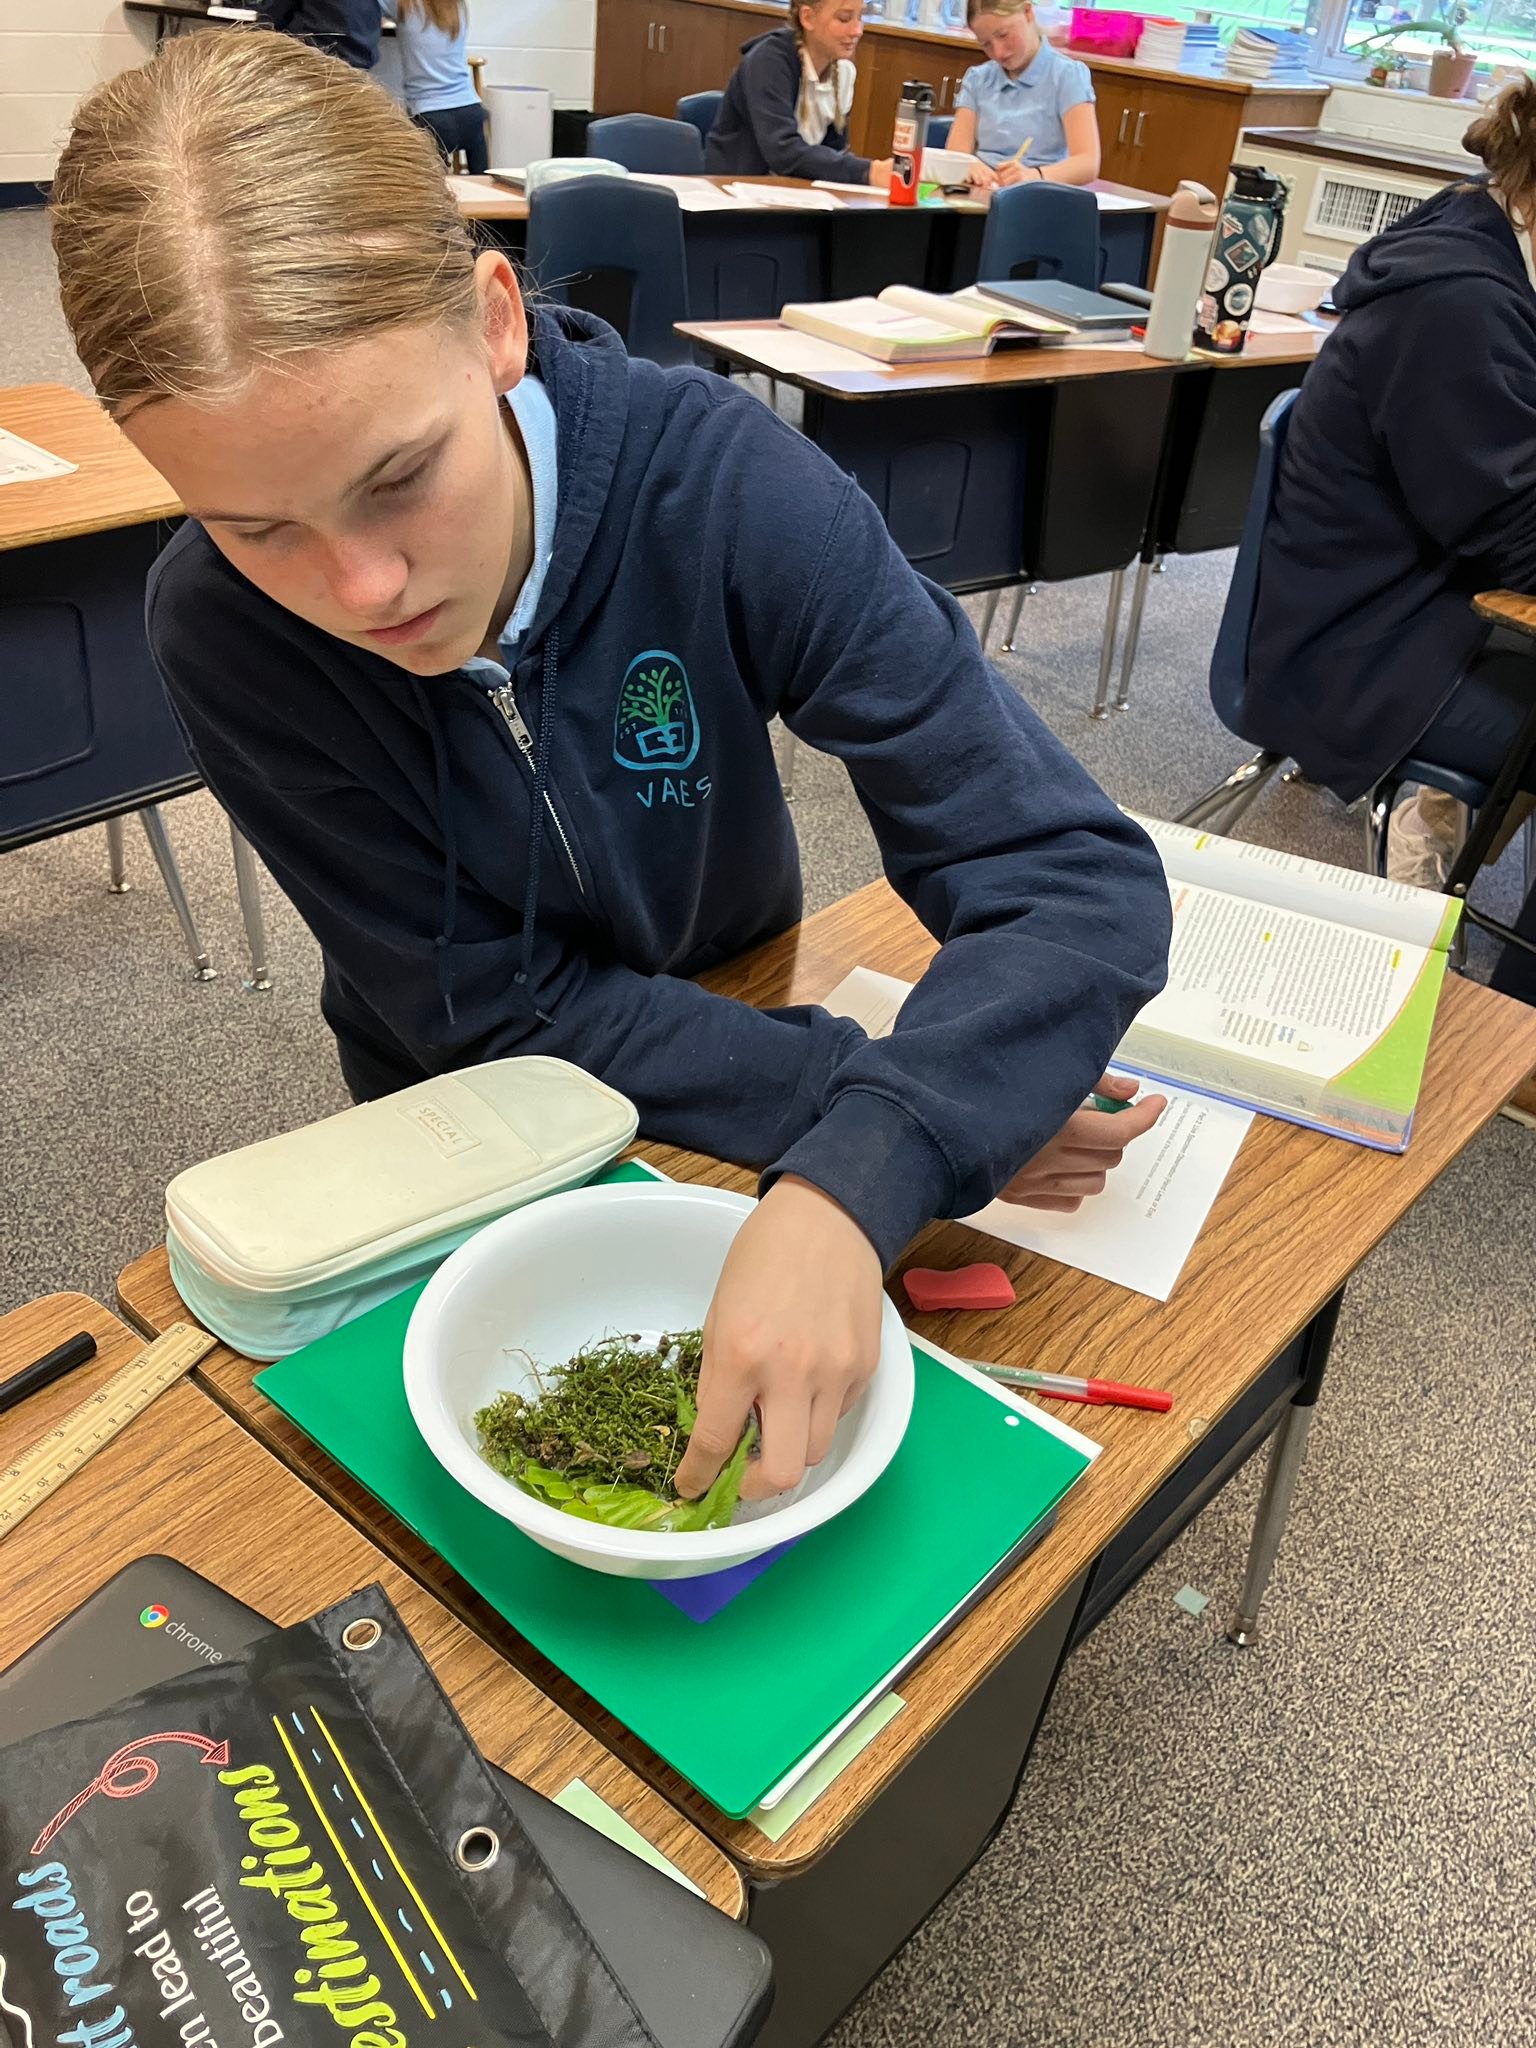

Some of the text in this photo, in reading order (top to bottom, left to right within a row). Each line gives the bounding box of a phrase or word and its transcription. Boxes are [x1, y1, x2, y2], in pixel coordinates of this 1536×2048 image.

[636, 776, 712, 808] VAES
[418, 1106, 463, 1144] SPECIAL
[164, 1622, 223, 1664] chrome
[11, 1861, 114, 2007] roads
[125, 1890, 160, 1935] to
[135, 1929, 198, 2020] lead
[181, 1882, 285, 2048] beautiful
